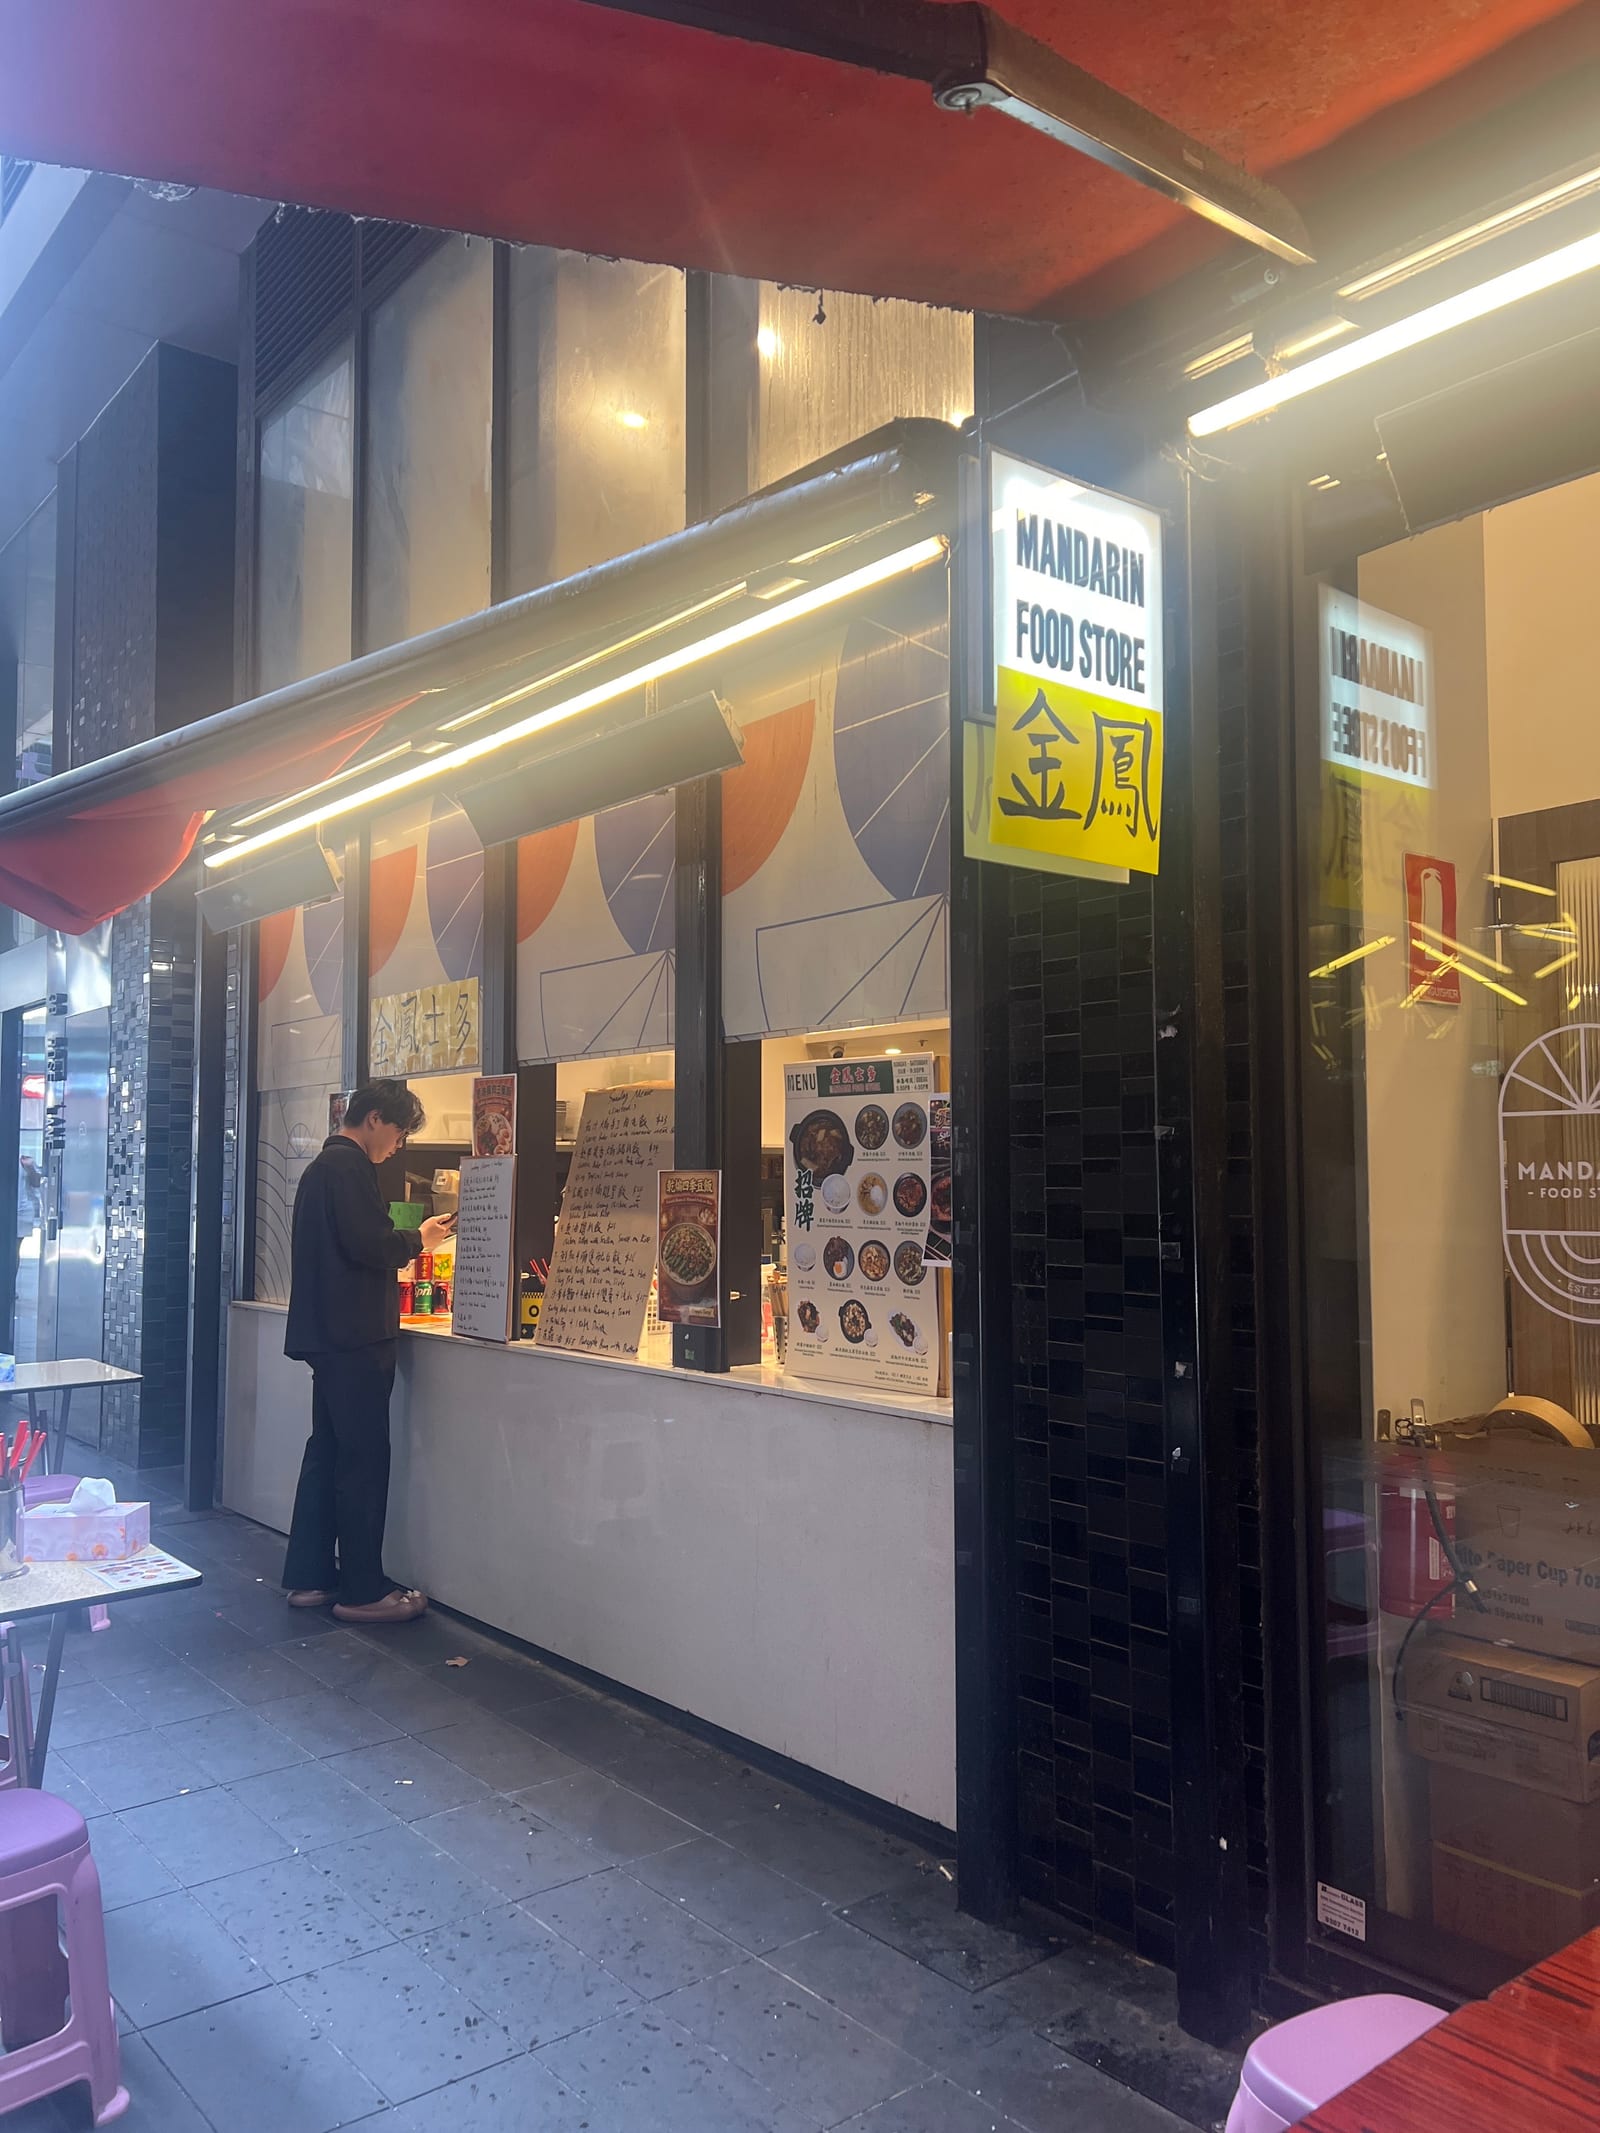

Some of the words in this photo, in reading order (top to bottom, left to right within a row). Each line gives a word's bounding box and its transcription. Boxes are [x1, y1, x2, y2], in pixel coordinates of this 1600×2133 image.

[1016, 509, 1145, 608] MANDARIN
[1016, 600, 1074, 672] FOOD
[1079, 622, 1145, 694] STORE
[998, 687, 1158, 841] 金鳳
[374, 988, 472, 1066] 金鳳士多
[787, 1073, 816, 1092] MENU
[794, 1168, 815, 1232] 招牌
[1518, 1161, 1600, 1181] MAND
[1540, 1188, 1582, 1199] FOOD
[1589, 1188, 1600, 1199] S
[1536, 1560, 1568, 1587] Cup
